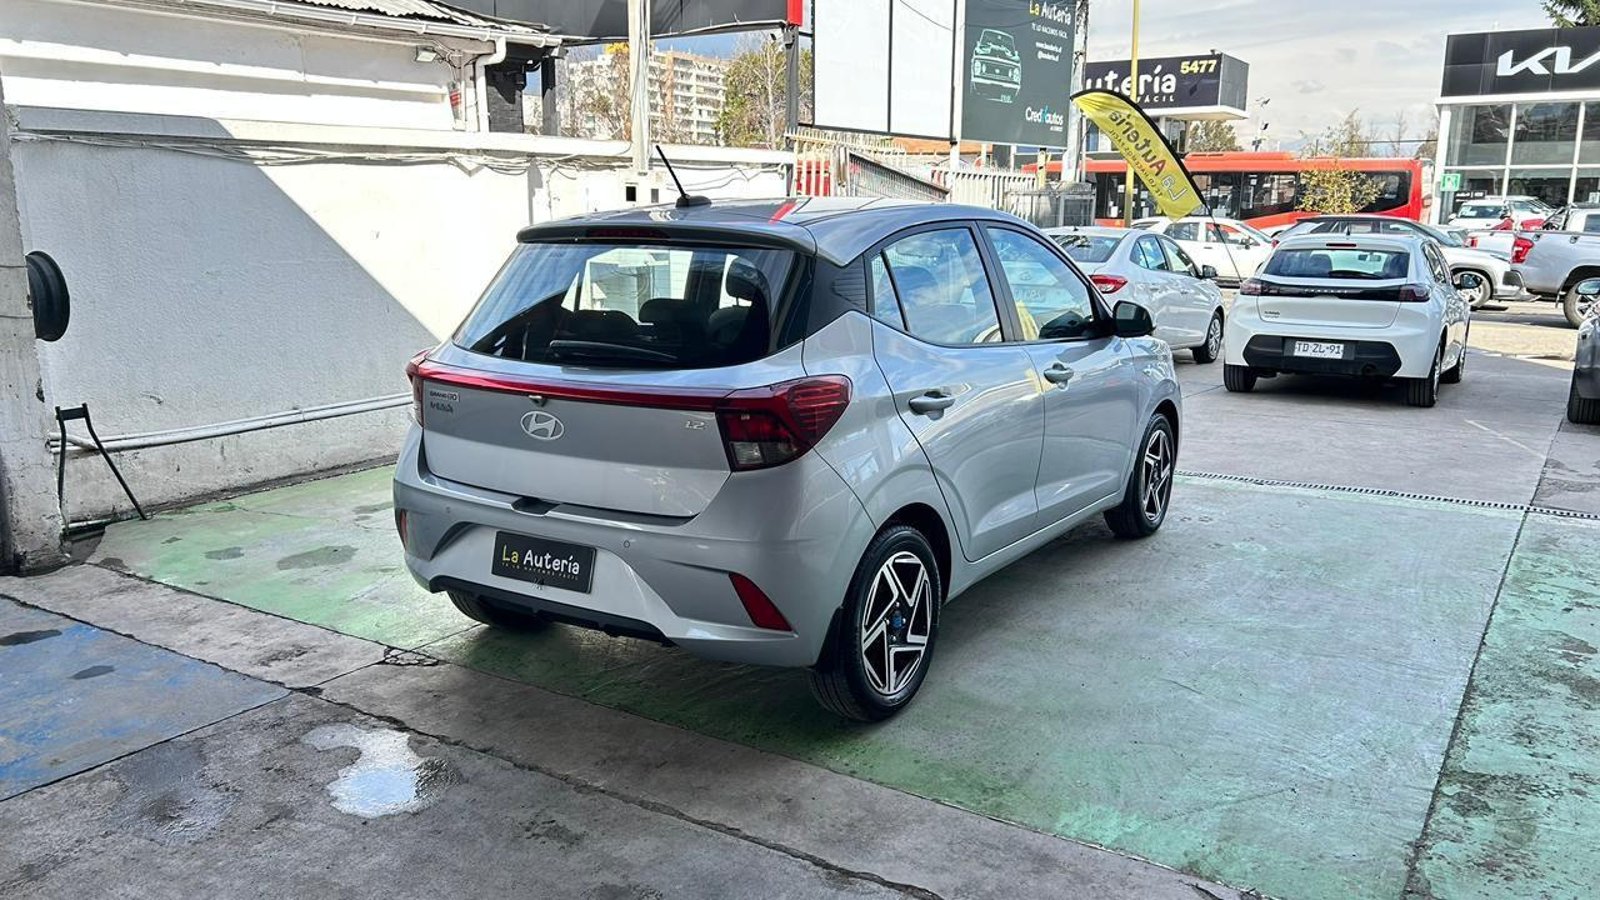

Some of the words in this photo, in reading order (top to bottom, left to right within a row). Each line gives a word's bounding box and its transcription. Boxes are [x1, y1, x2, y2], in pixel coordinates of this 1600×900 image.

[1029, 0, 1040, 16] La
[1180, 60, 1217, 74] 5477
[1085, 64, 1177, 96] utería
[502, 544, 519, 563] La
[523, 549, 580, 575] Autería
